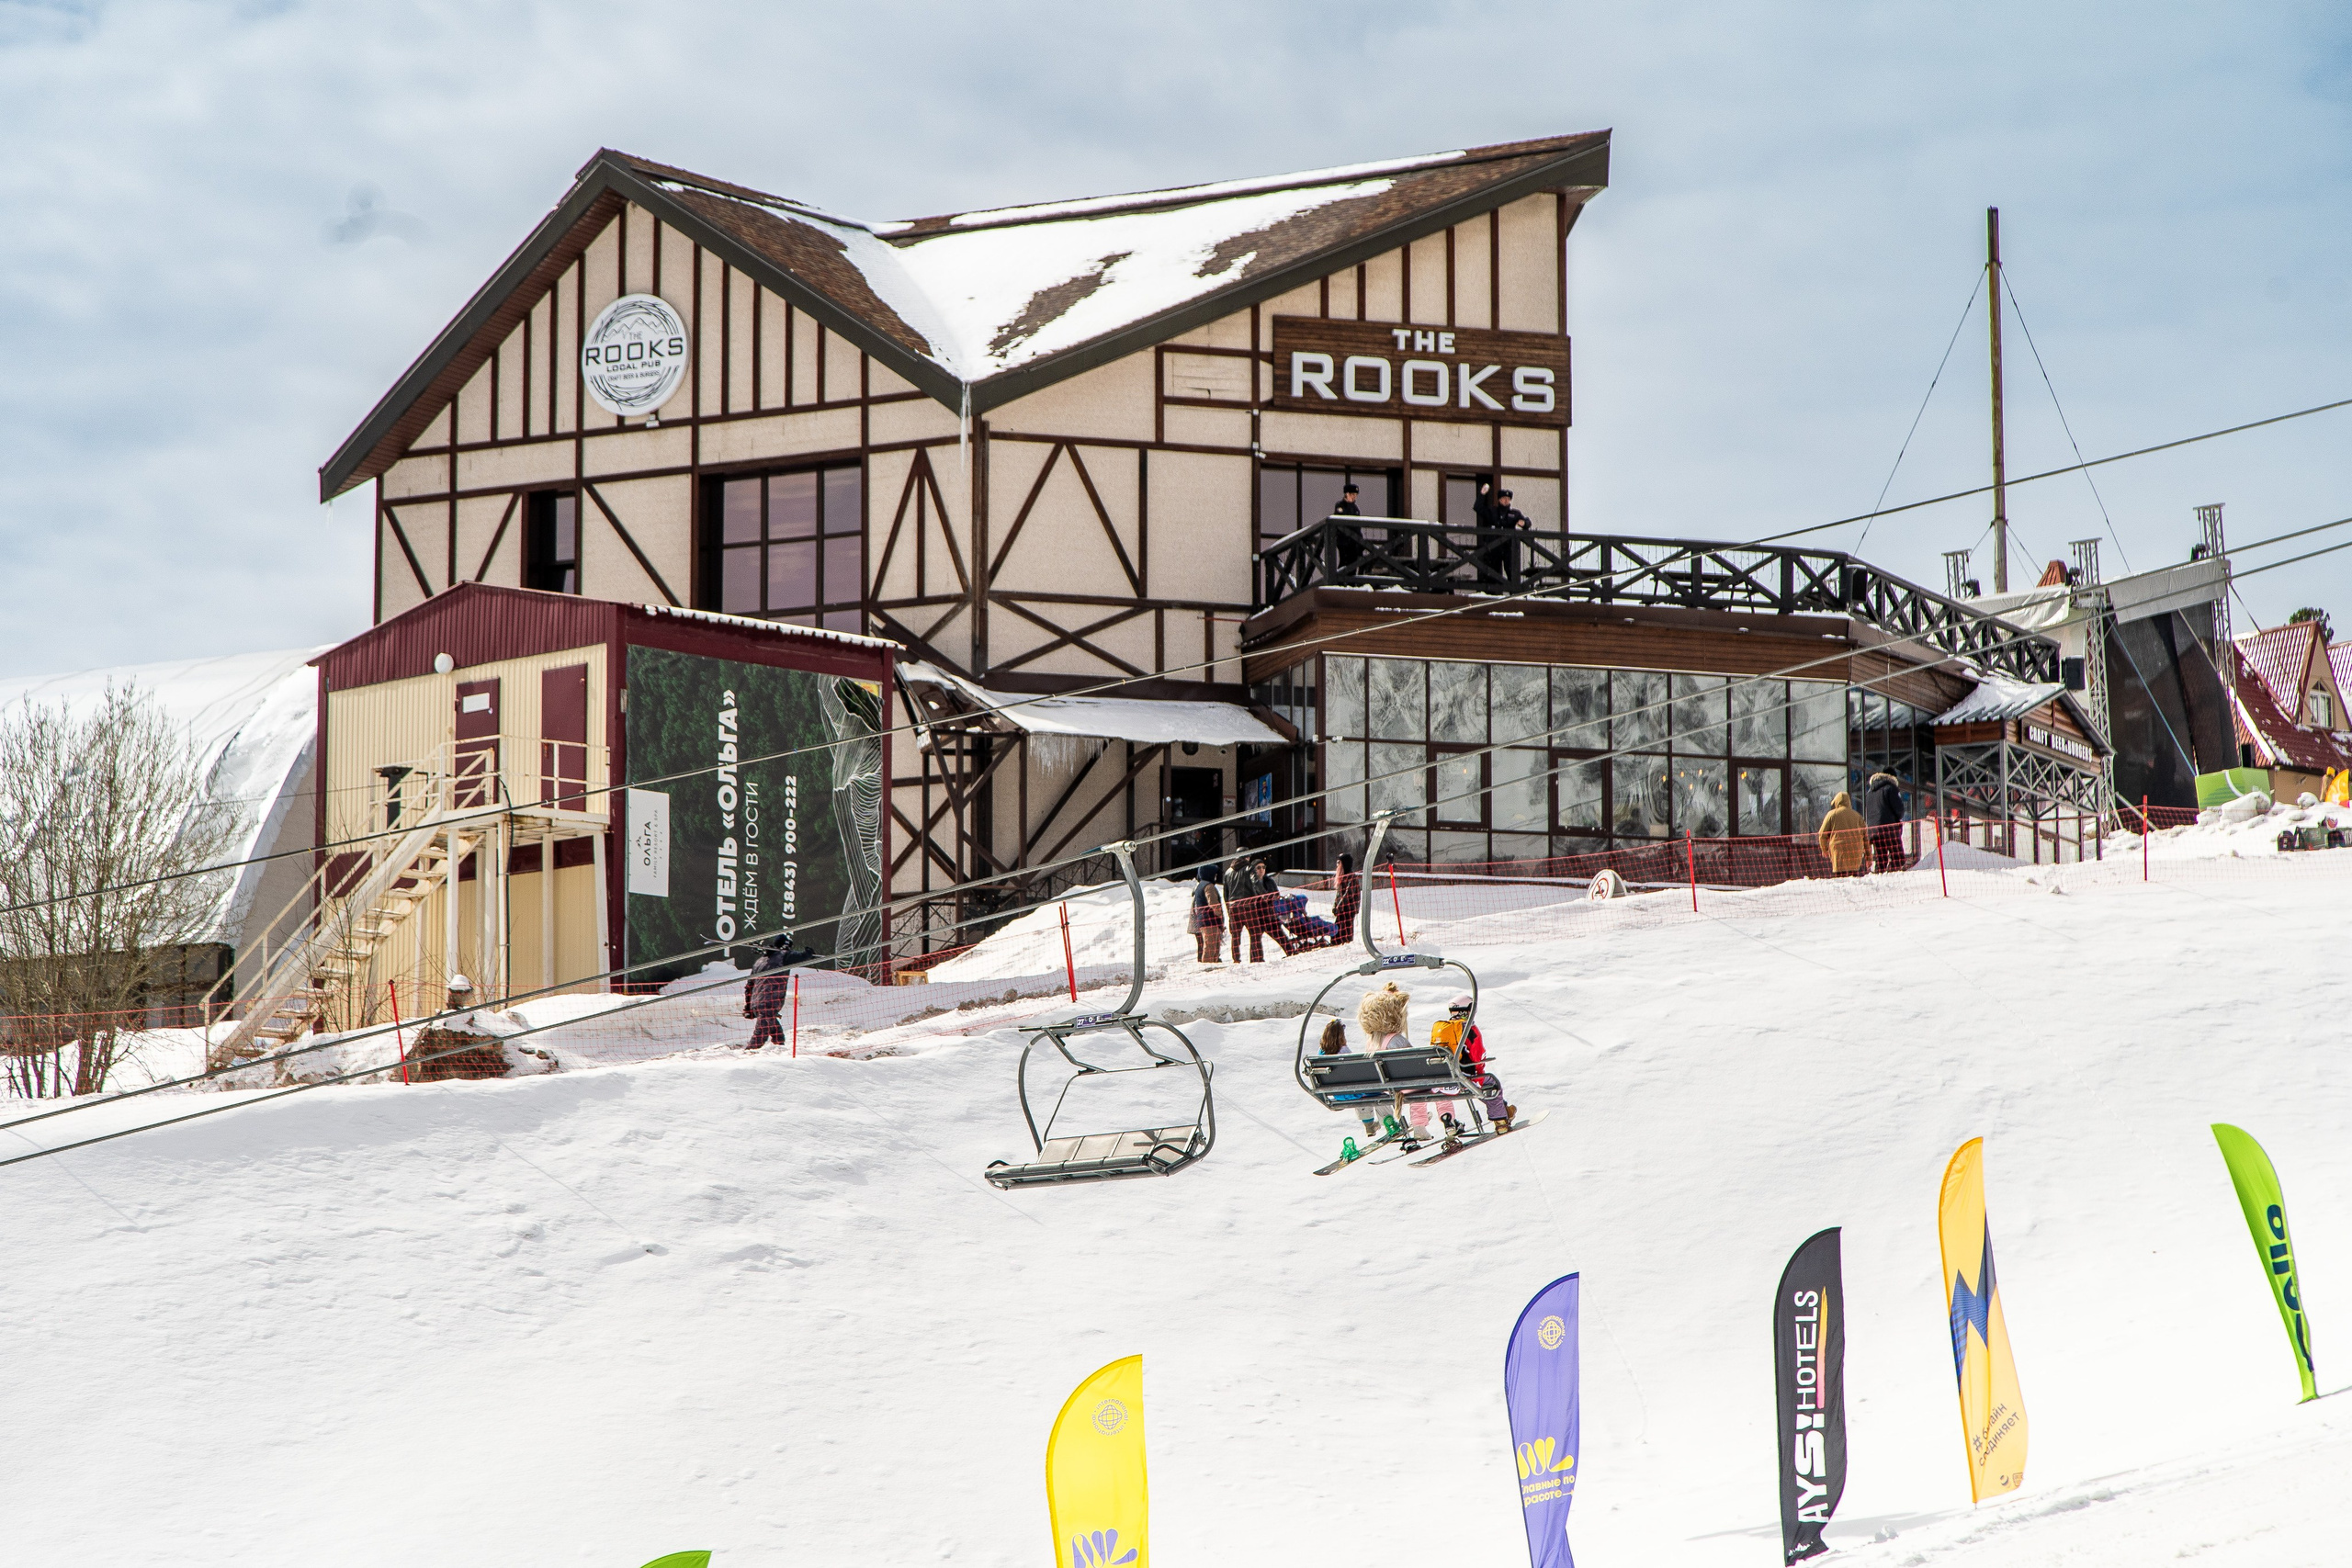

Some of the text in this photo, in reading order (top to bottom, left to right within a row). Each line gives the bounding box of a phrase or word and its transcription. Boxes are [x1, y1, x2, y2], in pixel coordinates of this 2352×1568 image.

[585, 336, 684, 367] ROOKS
[628, 331, 643, 341] THE
[1392, 328, 1455, 355] THE
[606, 359, 662, 373] LOCAL PUB
[1291, 351, 1555, 412] ROOKS
[2029, 725, 2049, 747] CRAFT
[718, 689, 738, 830] «ОЛЬГА»
[785, 774, 797, 854] 900-222
[741, 782, 759, 931] ЖДЁМ В ГОСТИ
[782, 860, 797, 920] (3843)
[1793, 1290, 1819, 1410] HOTELS
[1521, 1474, 1576, 1495] лавные по
[1523, 1489, 1563, 1508] расоте
